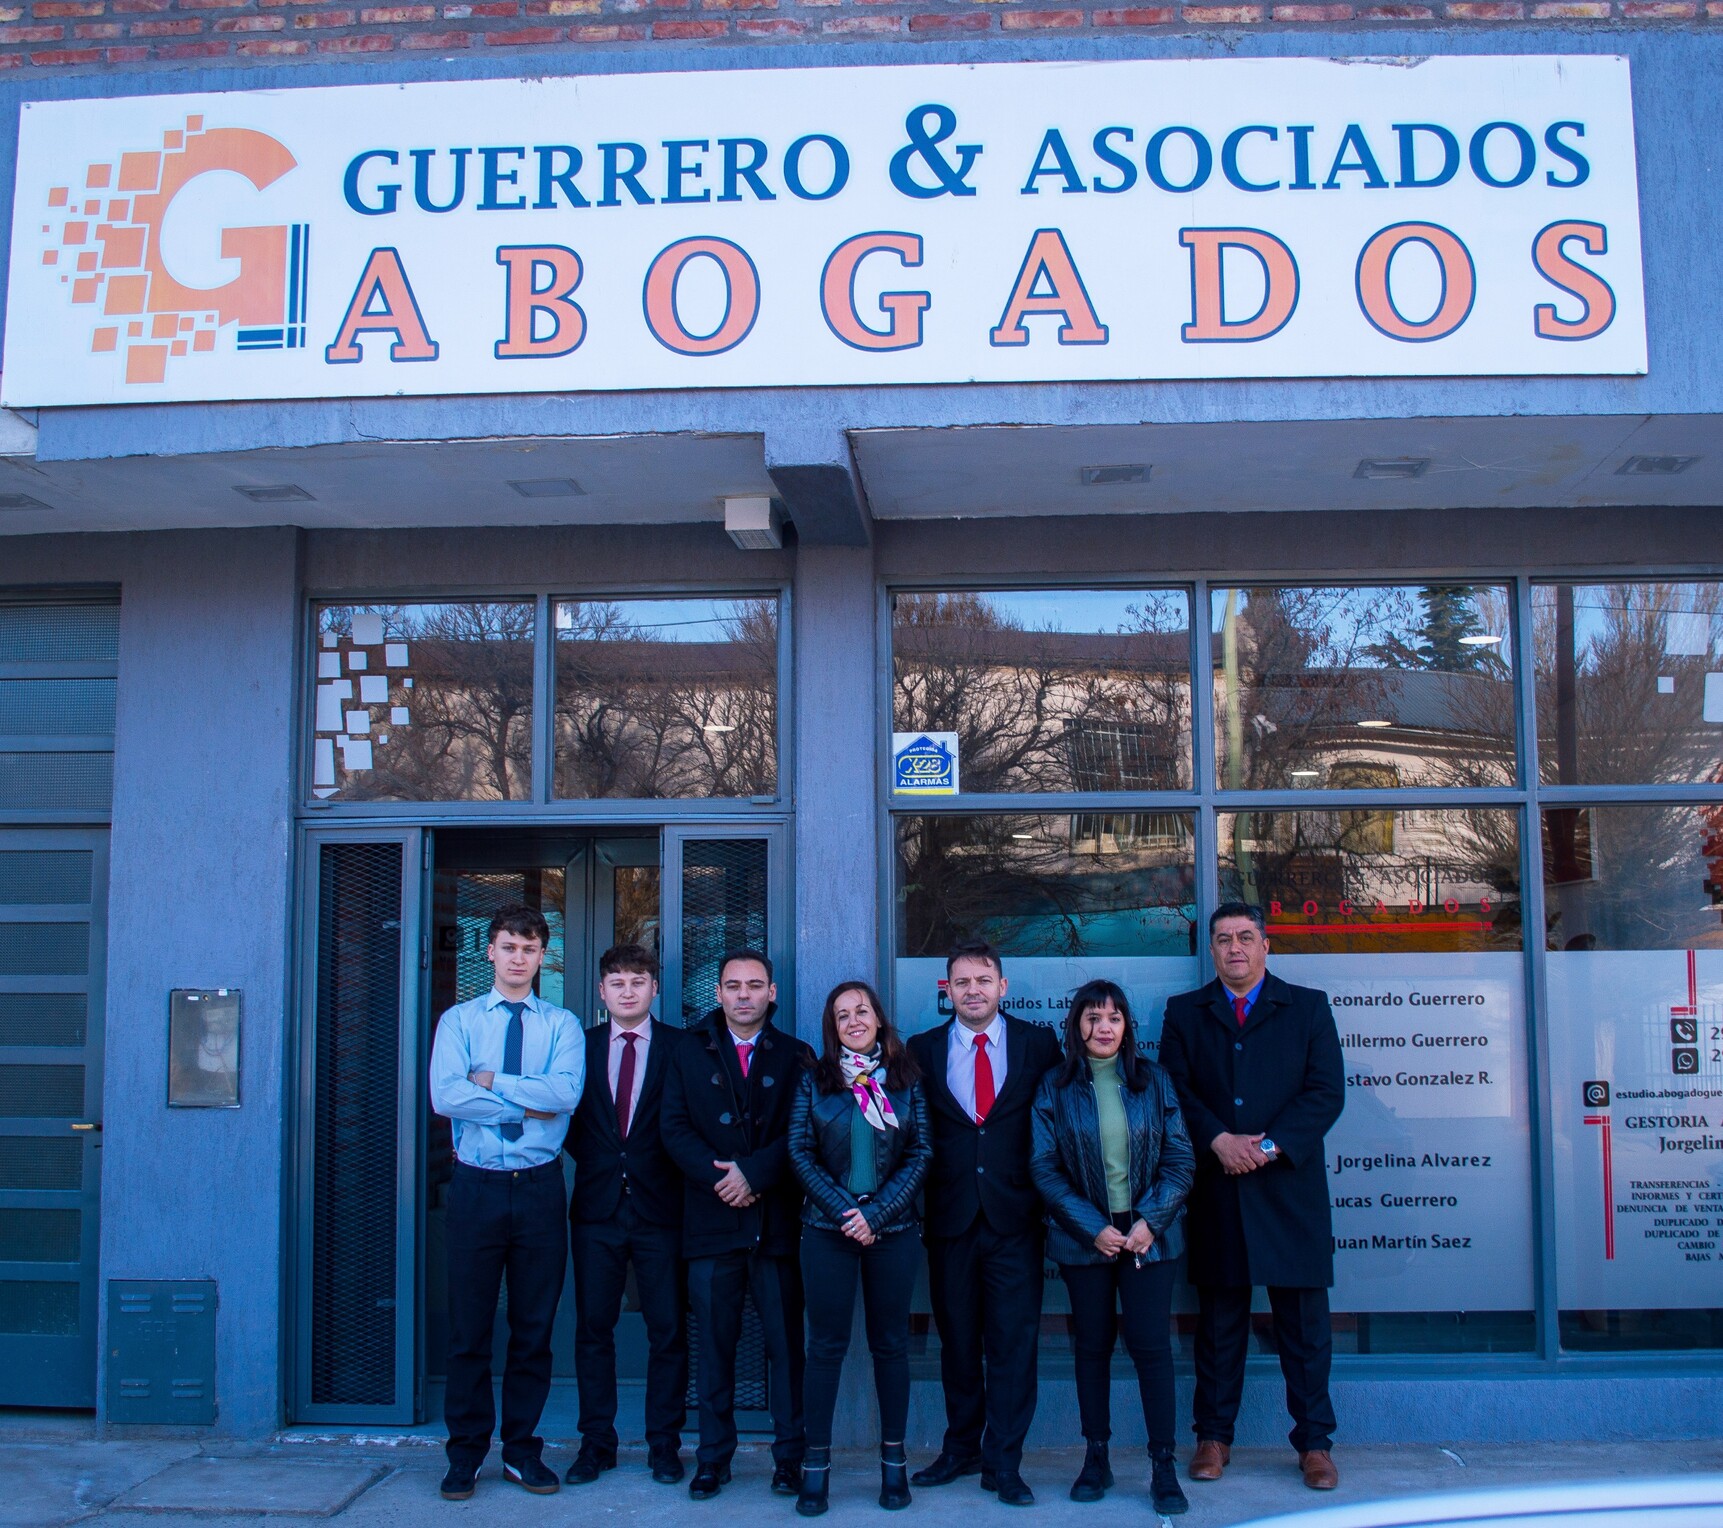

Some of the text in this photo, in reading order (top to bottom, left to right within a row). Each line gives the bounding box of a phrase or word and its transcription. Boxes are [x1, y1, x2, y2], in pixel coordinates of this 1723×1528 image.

[343, 103, 1592, 214] GUERRERO & ASOCIADOS
[325, 219, 1617, 364] ABOGADOS
[900, 778, 950, 786] ALARMAS
[1380, 867, 1495, 885] ASOCIADOS
[1270, 897, 1492, 917] BOGADOS
[1408, 992, 1485, 1006] Guerrero
[1411, 1033, 1488, 1047] Guerrero
[1346, 1071, 1493, 1087] stavo Gonzalez R.
[1625, 1115, 1709, 1129] GESTORIA
[1334, 1152, 1492, 1174] Jorgelina Alvarez
[1630, 1180, 1710, 1189] TRANSFERENCIAS
[1330, 1193, 1458, 1208] ucas Guerrero
[1631, 1192, 1680, 1201] INFORMES
[1685, 1192, 1692, 1200] Y
[1616, 1204, 1723, 1213] DENUNCIA DE VENTA
[1654, 1218, 1709, 1227] DUPLICADO
[1644, 1230, 1720, 1239] DUPLICADO DE
[1331, 1234, 1472, 1254] Juan Martín Saez
[1677, 1241, 1715, 1250] CAMBIO
[1685, 1253, 1711, 1262] BAJAS
